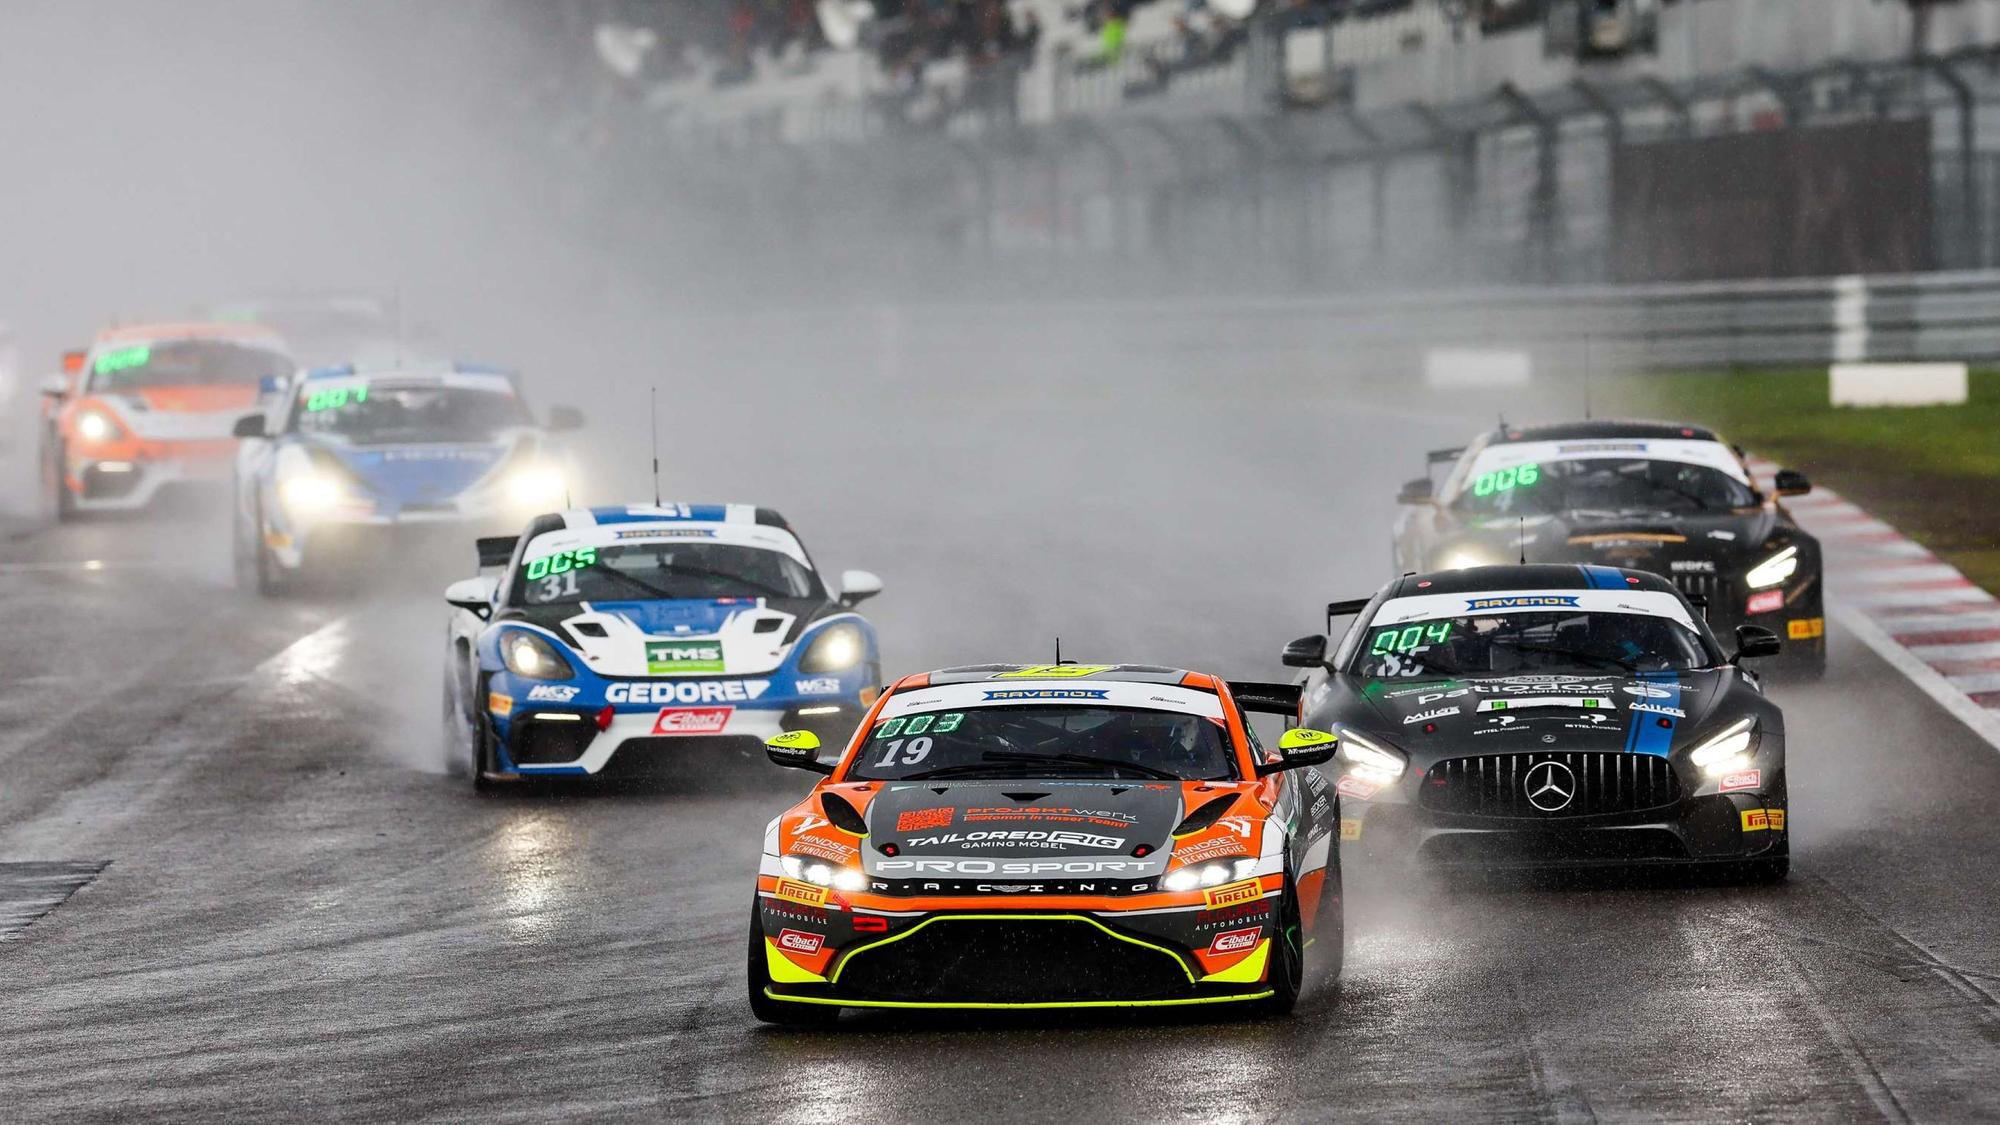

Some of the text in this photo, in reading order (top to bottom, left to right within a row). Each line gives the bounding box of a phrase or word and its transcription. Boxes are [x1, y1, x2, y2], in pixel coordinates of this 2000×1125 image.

[539, 570, 581, 602] 31
[1474, 597, 1573, 608] RAVENOL
[1371, 622, 1451, 656] 004
[650, 648, 719, 661] TMS
[605, 681, 745, 704] GEDORE
[875, 713, 965, 739] 003
[874, 736, 933, 768] 19
[797, 833, 860, 856] MINDSET
[906, 830, 1049, 847] TAILORED
[961, 840, 1068, 850] GAMING MÖBEL
[1169, 834, 1237, 860] MINDSET
[789, 841, 851, 865] TECHNOLOGIES
[1180, 844, 1248, 866] TECHNOLOGIES
[876, 860, 1156, 875] PRO SPORT
[778, 880, 824, 903] PIRELLI
[1208, 881, 1259, 906] PIRELLI
[1194, 911, 1270, 931] AUTOMOBILE
[780, 932, 820, 951] Eibach
[1215, 931, 1257, 950] Eibach
